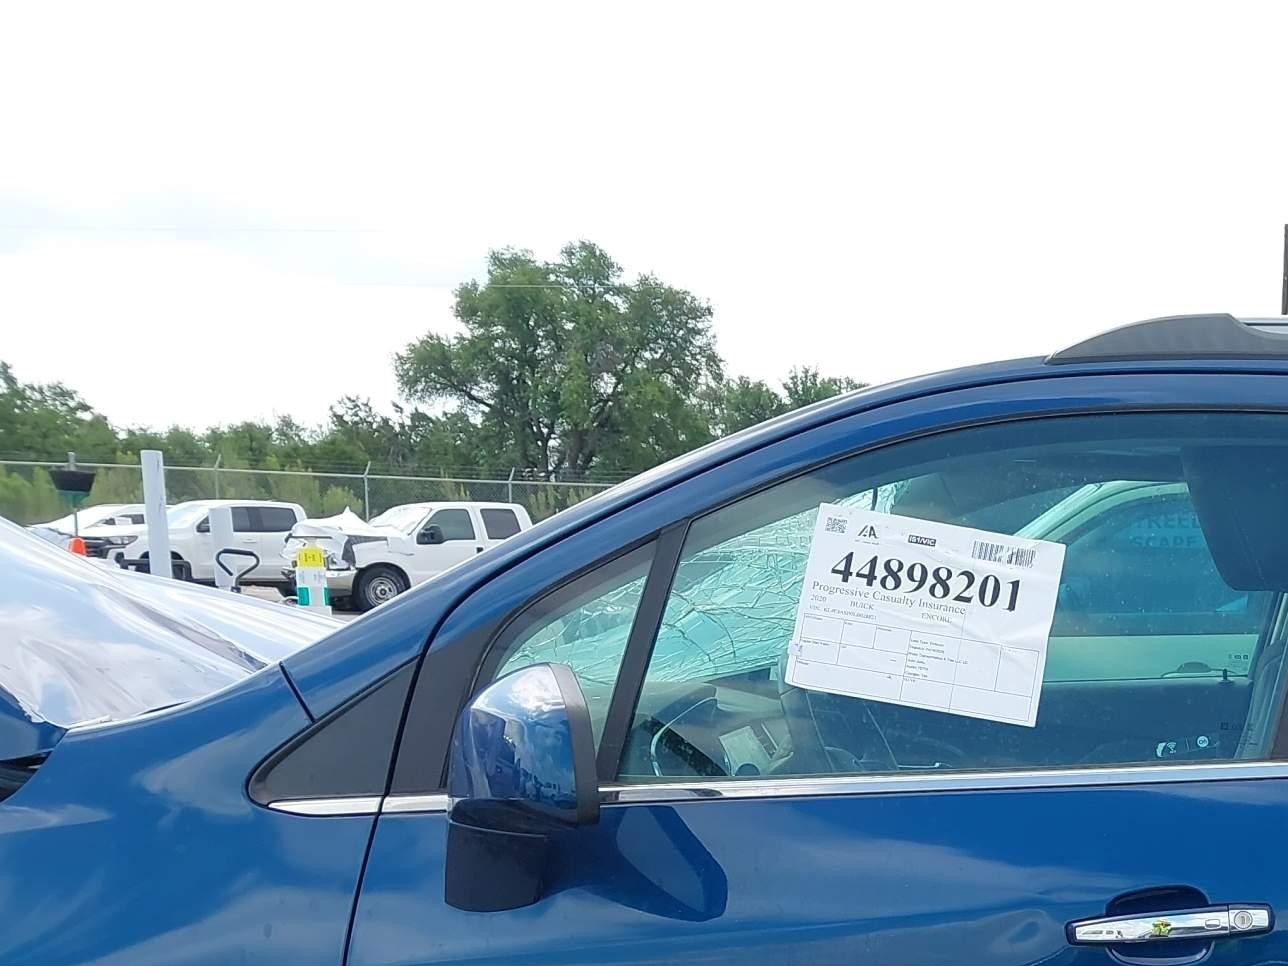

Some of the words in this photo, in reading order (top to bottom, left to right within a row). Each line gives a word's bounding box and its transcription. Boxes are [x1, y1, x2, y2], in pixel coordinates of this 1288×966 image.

[812, 581, 869, 598] Progressive
[873, 591, 915, 608] Casualty
[918, 598, 966, 614] Insurance
[831, 551, 1021, 612] 44898201
[850, 601, 875, 611] BUICK
